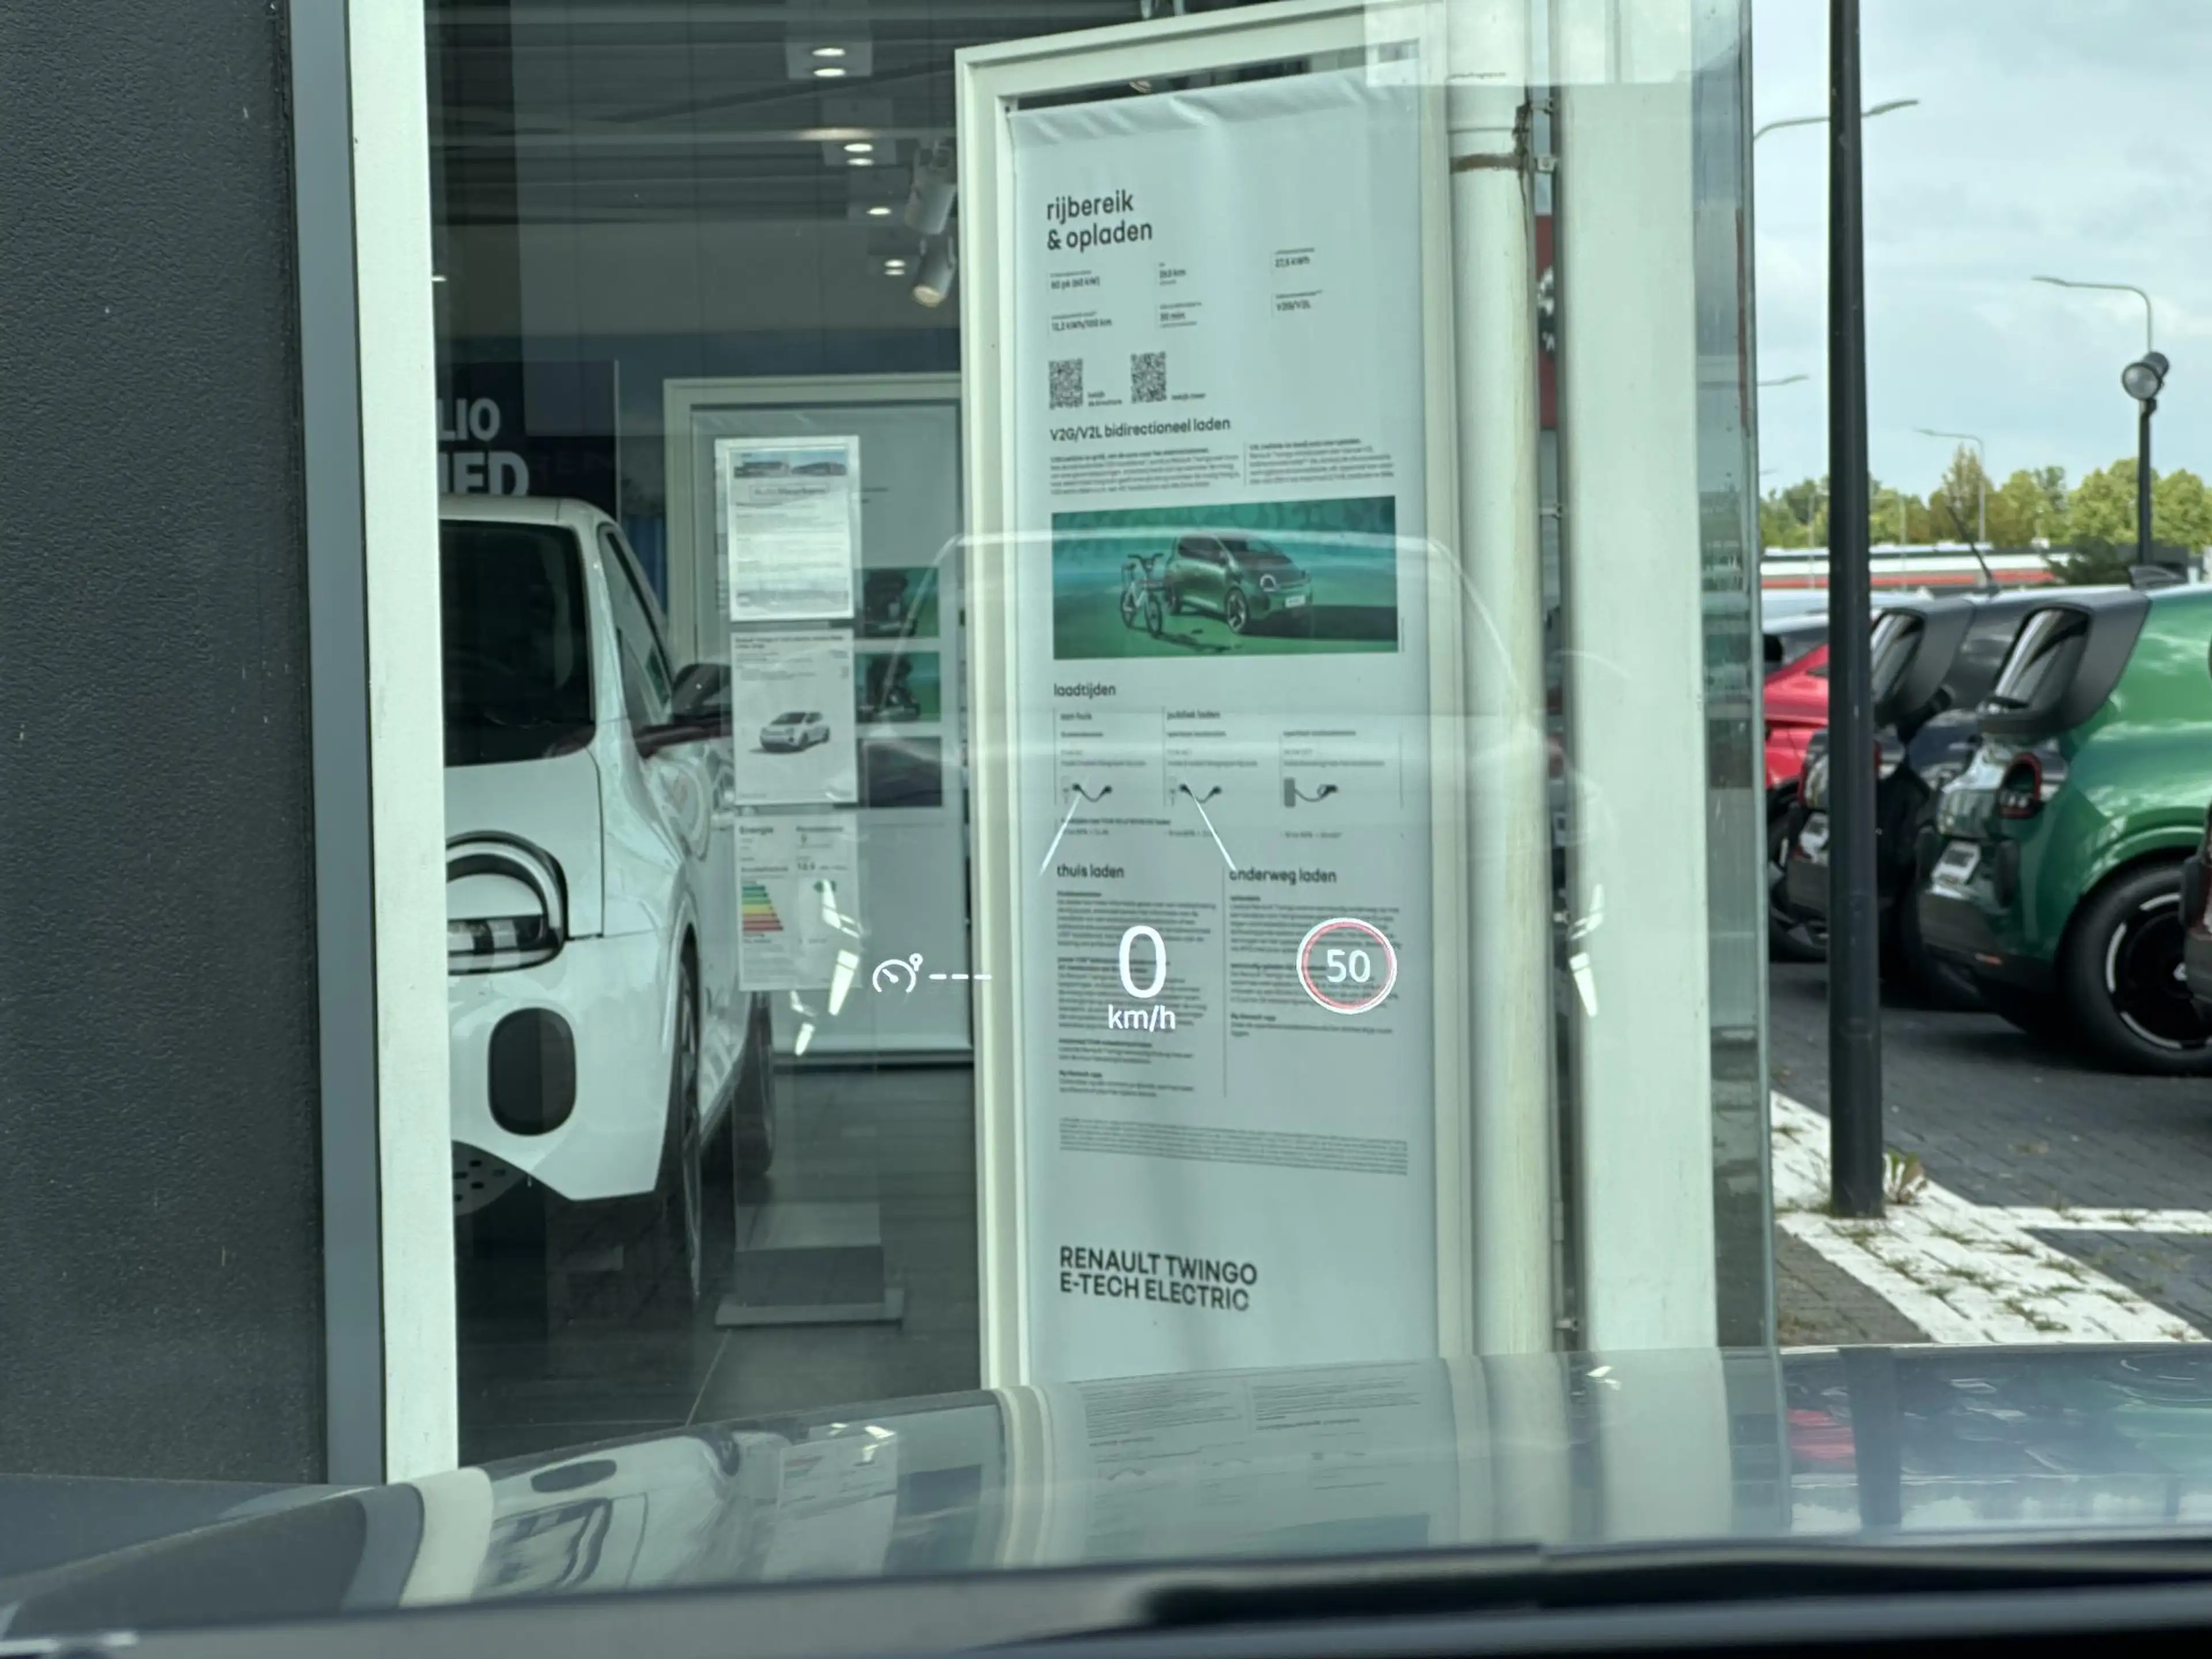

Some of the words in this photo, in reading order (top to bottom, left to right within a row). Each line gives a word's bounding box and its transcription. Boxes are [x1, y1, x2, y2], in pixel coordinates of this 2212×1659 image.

[1047, 189, 1134, 225] rijbereik
[1047, 229, 1062, 251] &
[1066, 219, 1153, 253] opladen
[1050, 427, 1103, 443] V2G/V2L
[1104, 418, 1191, 438] bidirectioneel
[1193, 416, 1232, 432] laden
[1054, 681, 1116, 699] laadtijden
[1056, 862, 1088, 878] thuis
[1089, 863, 1124, 879] laden
[1229, 866, 1297, 886] onderweg
[1298, 868, 1337, 883] laden
[1119, 925, 1167, 999] 0
[1327, 949, 1370, 983] 50
[1108, 1003, 1176, 1032] km/h
[1059, 1245, 1161, 1275] RENAULT
[1164, 1253, 1257, 1286] TWINGO
[1060, 1271, 1140, 1300] E-TECH
[1144, 1278, 1250, 1312] ELECTRIC
